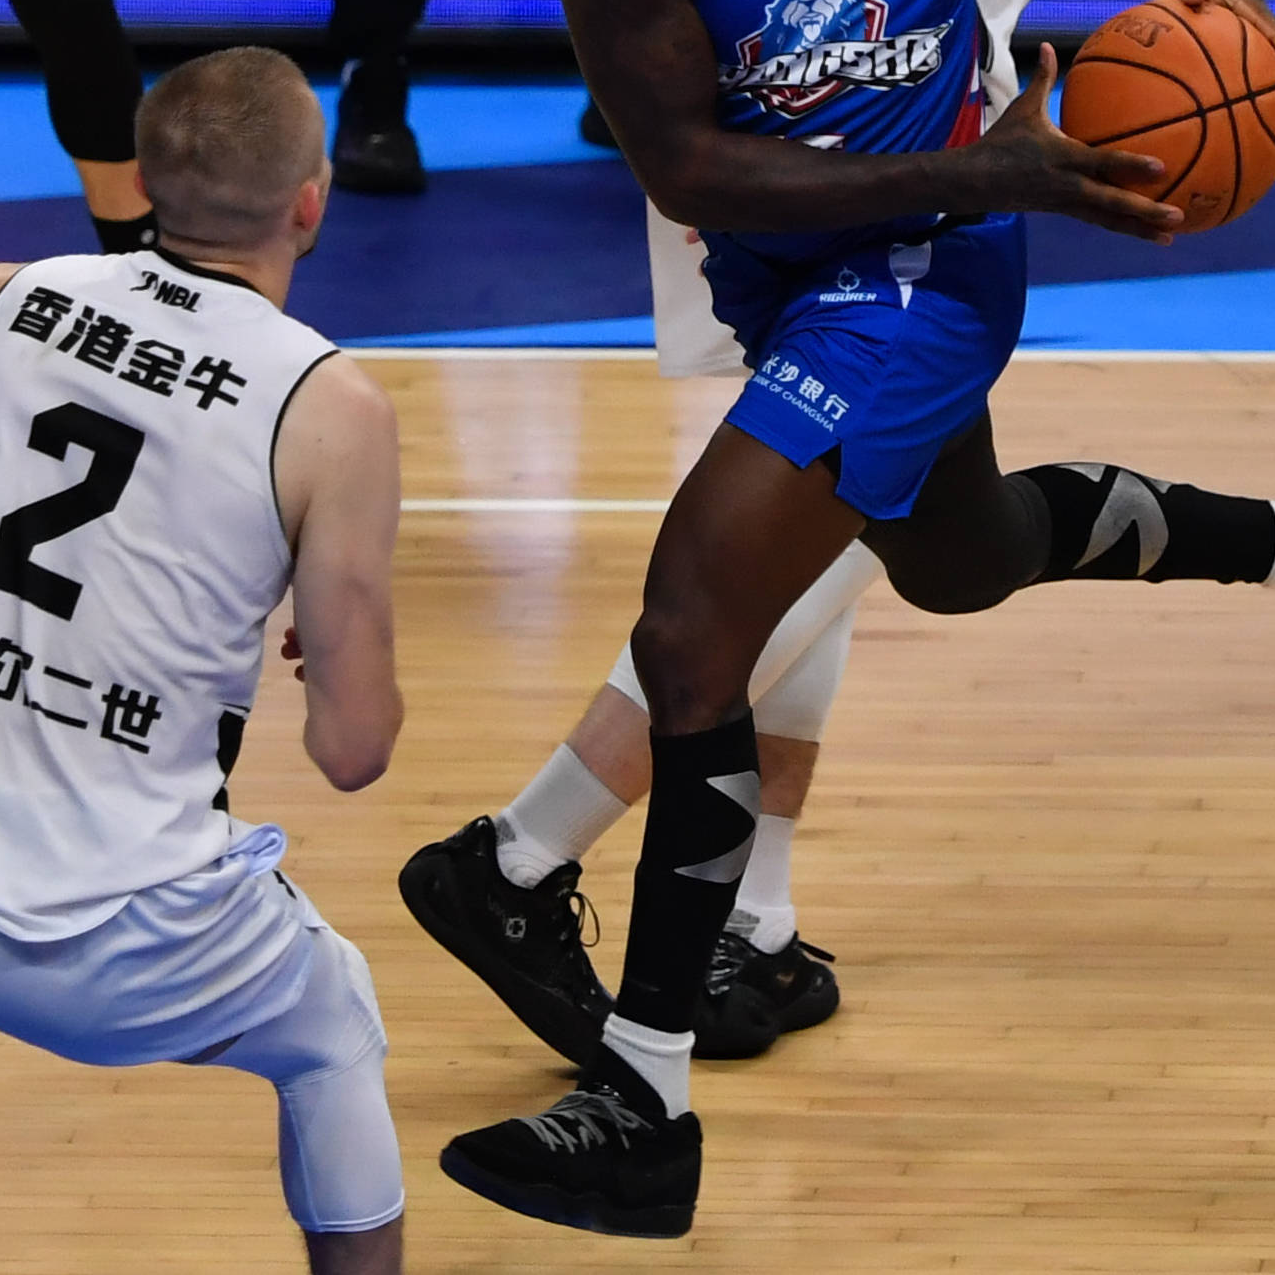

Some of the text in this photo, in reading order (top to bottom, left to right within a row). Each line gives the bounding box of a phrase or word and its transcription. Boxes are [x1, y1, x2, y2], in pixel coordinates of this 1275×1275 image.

[153, 281, 201, 313] NBL
[8, 286, 248, 411] 香港金牛
[762, 353, 850, 420] 长沙银行
